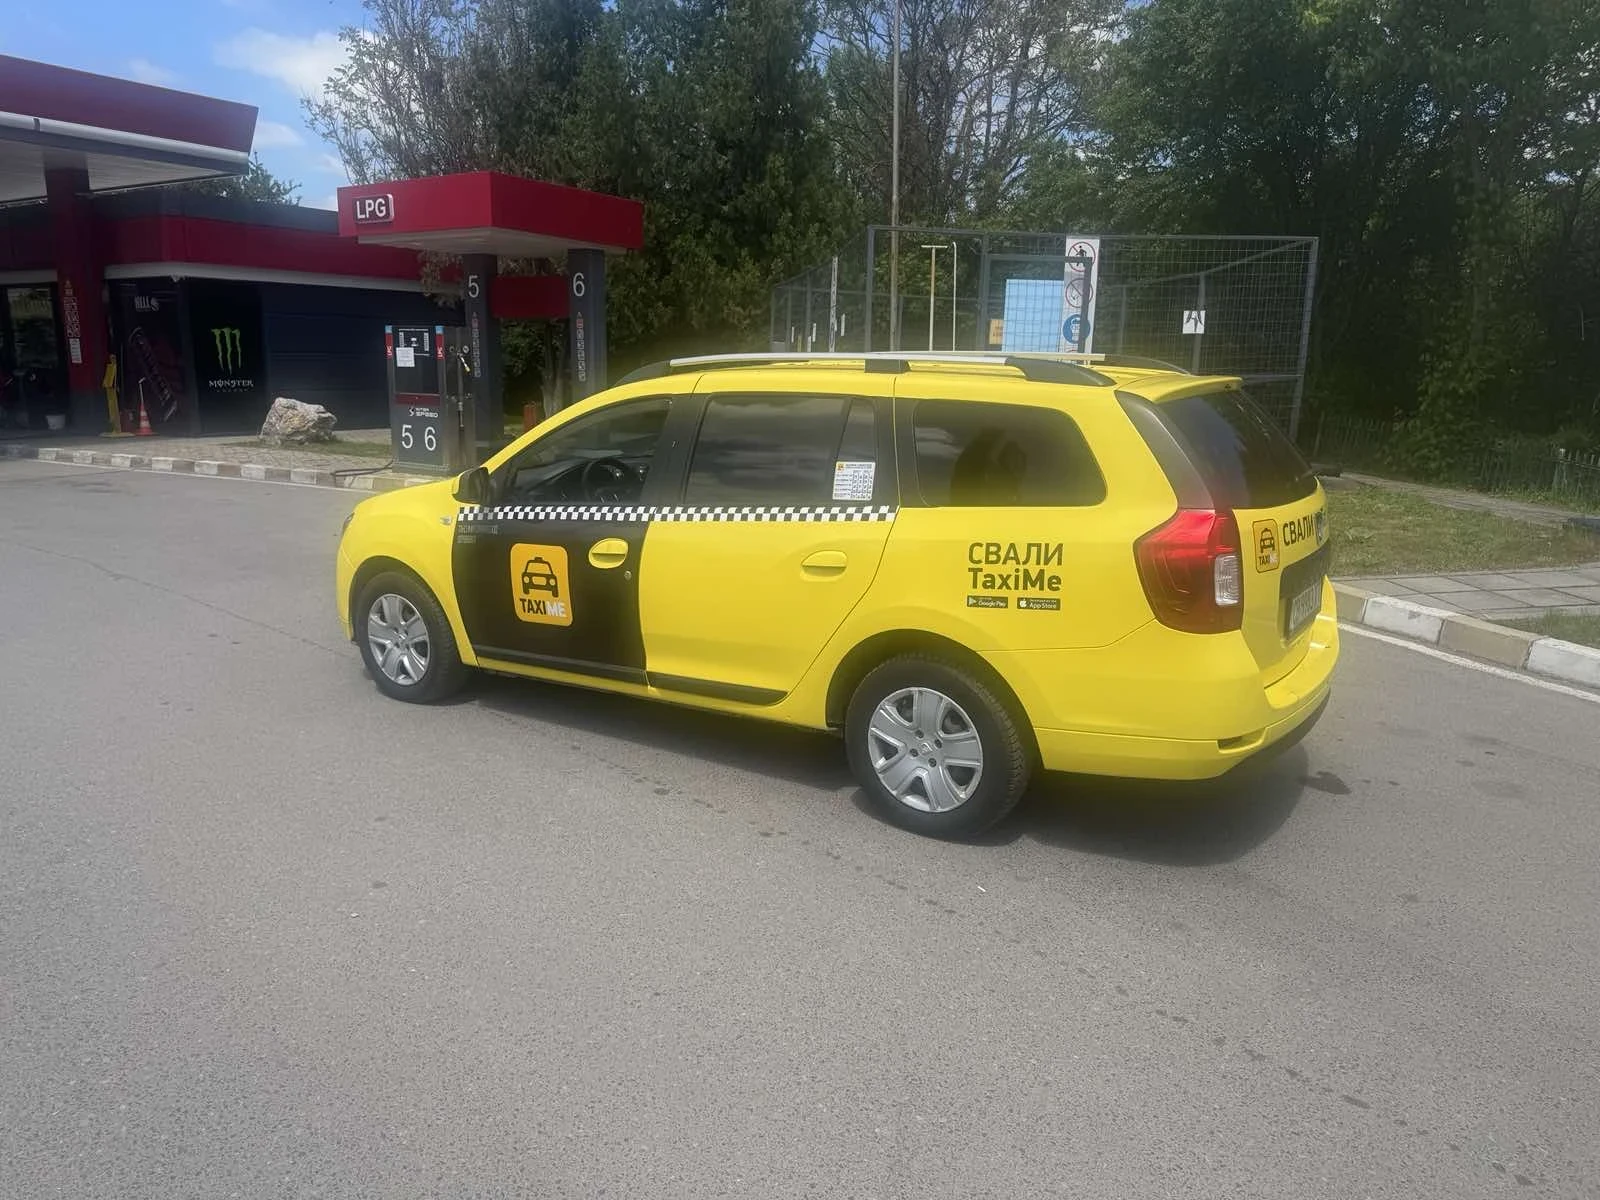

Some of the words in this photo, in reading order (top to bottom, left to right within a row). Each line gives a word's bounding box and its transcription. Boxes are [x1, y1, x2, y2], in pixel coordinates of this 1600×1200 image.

[356, 198, 386, 219] LPG
[468, 275, 480, 298] 5
[573, 272, 585, 297] 6
[208, 379, 254, 388] MONSTER
[401, 424, 413, 449] 5
[424, 426, 437, 451] 6
[1283, 514, 1315, 546] СВАЛИ
[968, 542, 1064, 566] СВАЛИ
[967, 567, 1062, 592] TaxiMe
[519, 598, 568, 618] TAXIME
